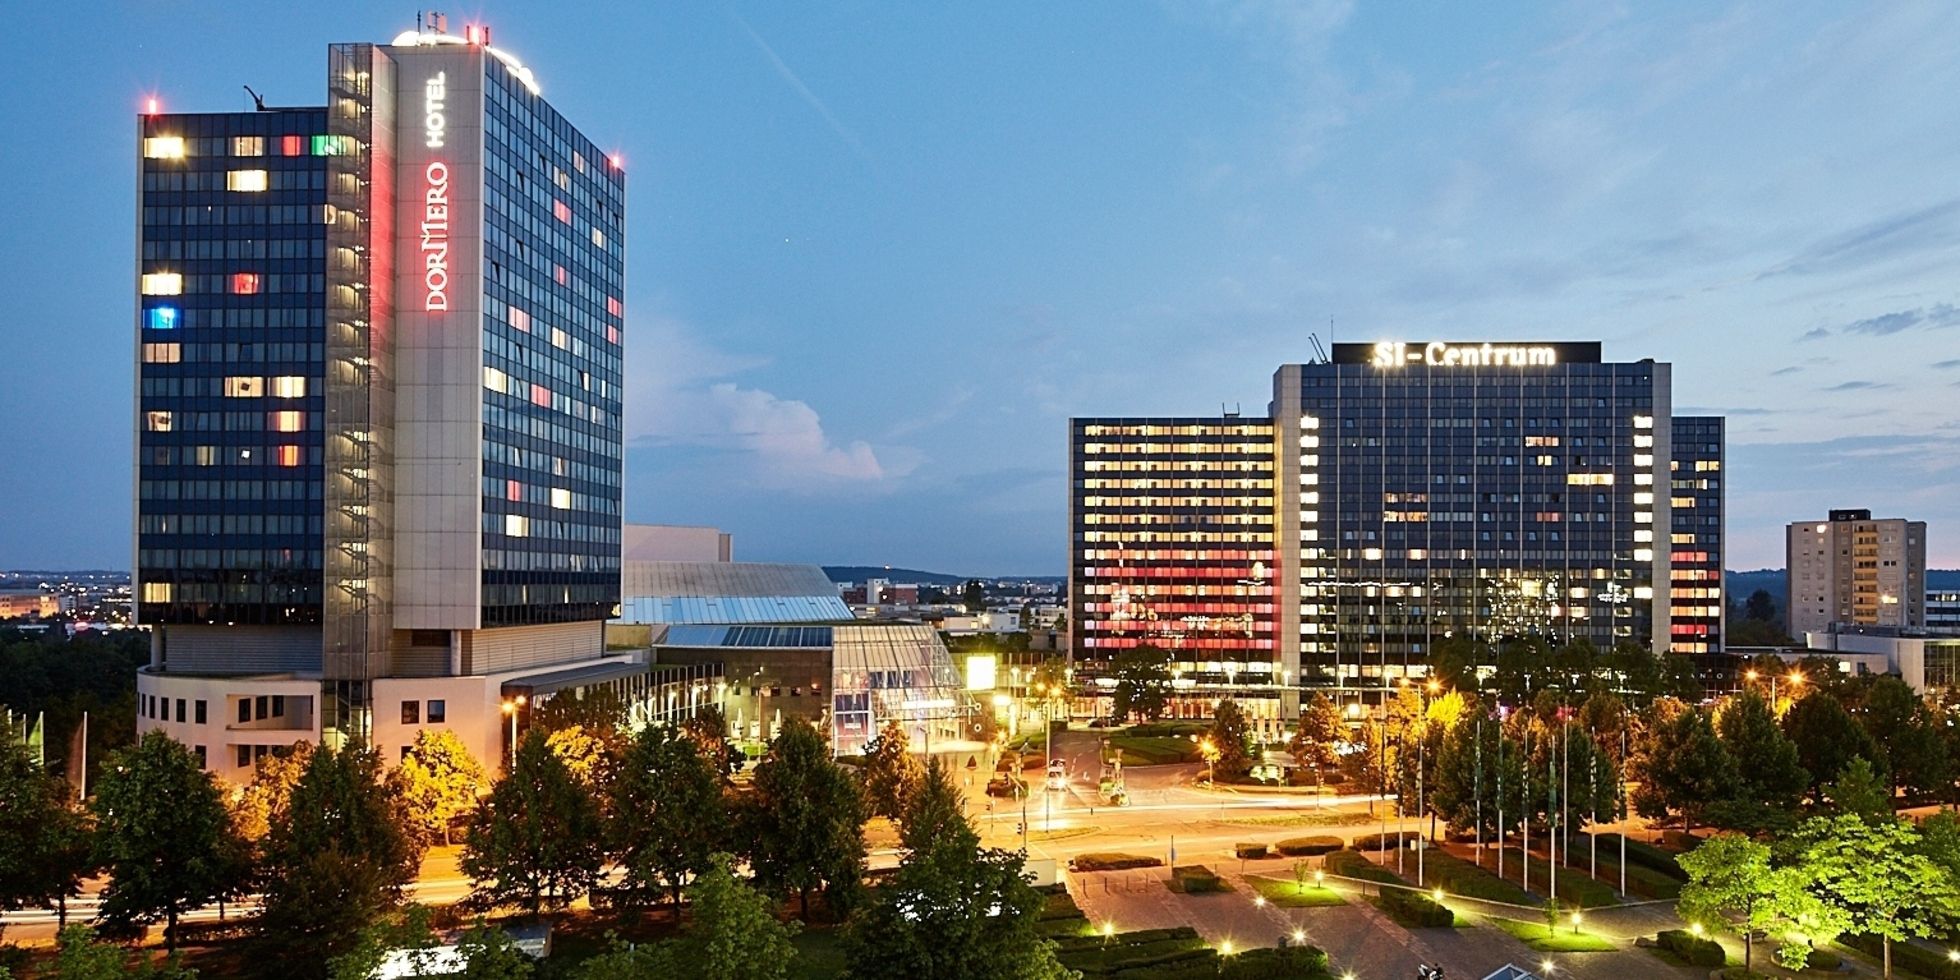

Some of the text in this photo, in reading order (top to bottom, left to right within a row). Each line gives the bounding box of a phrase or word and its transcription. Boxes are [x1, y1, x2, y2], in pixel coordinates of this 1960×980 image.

[420, 71, 449, 312] DORMERO HOTEL
[1373, 341, 1556, 367] SI-Centrum
